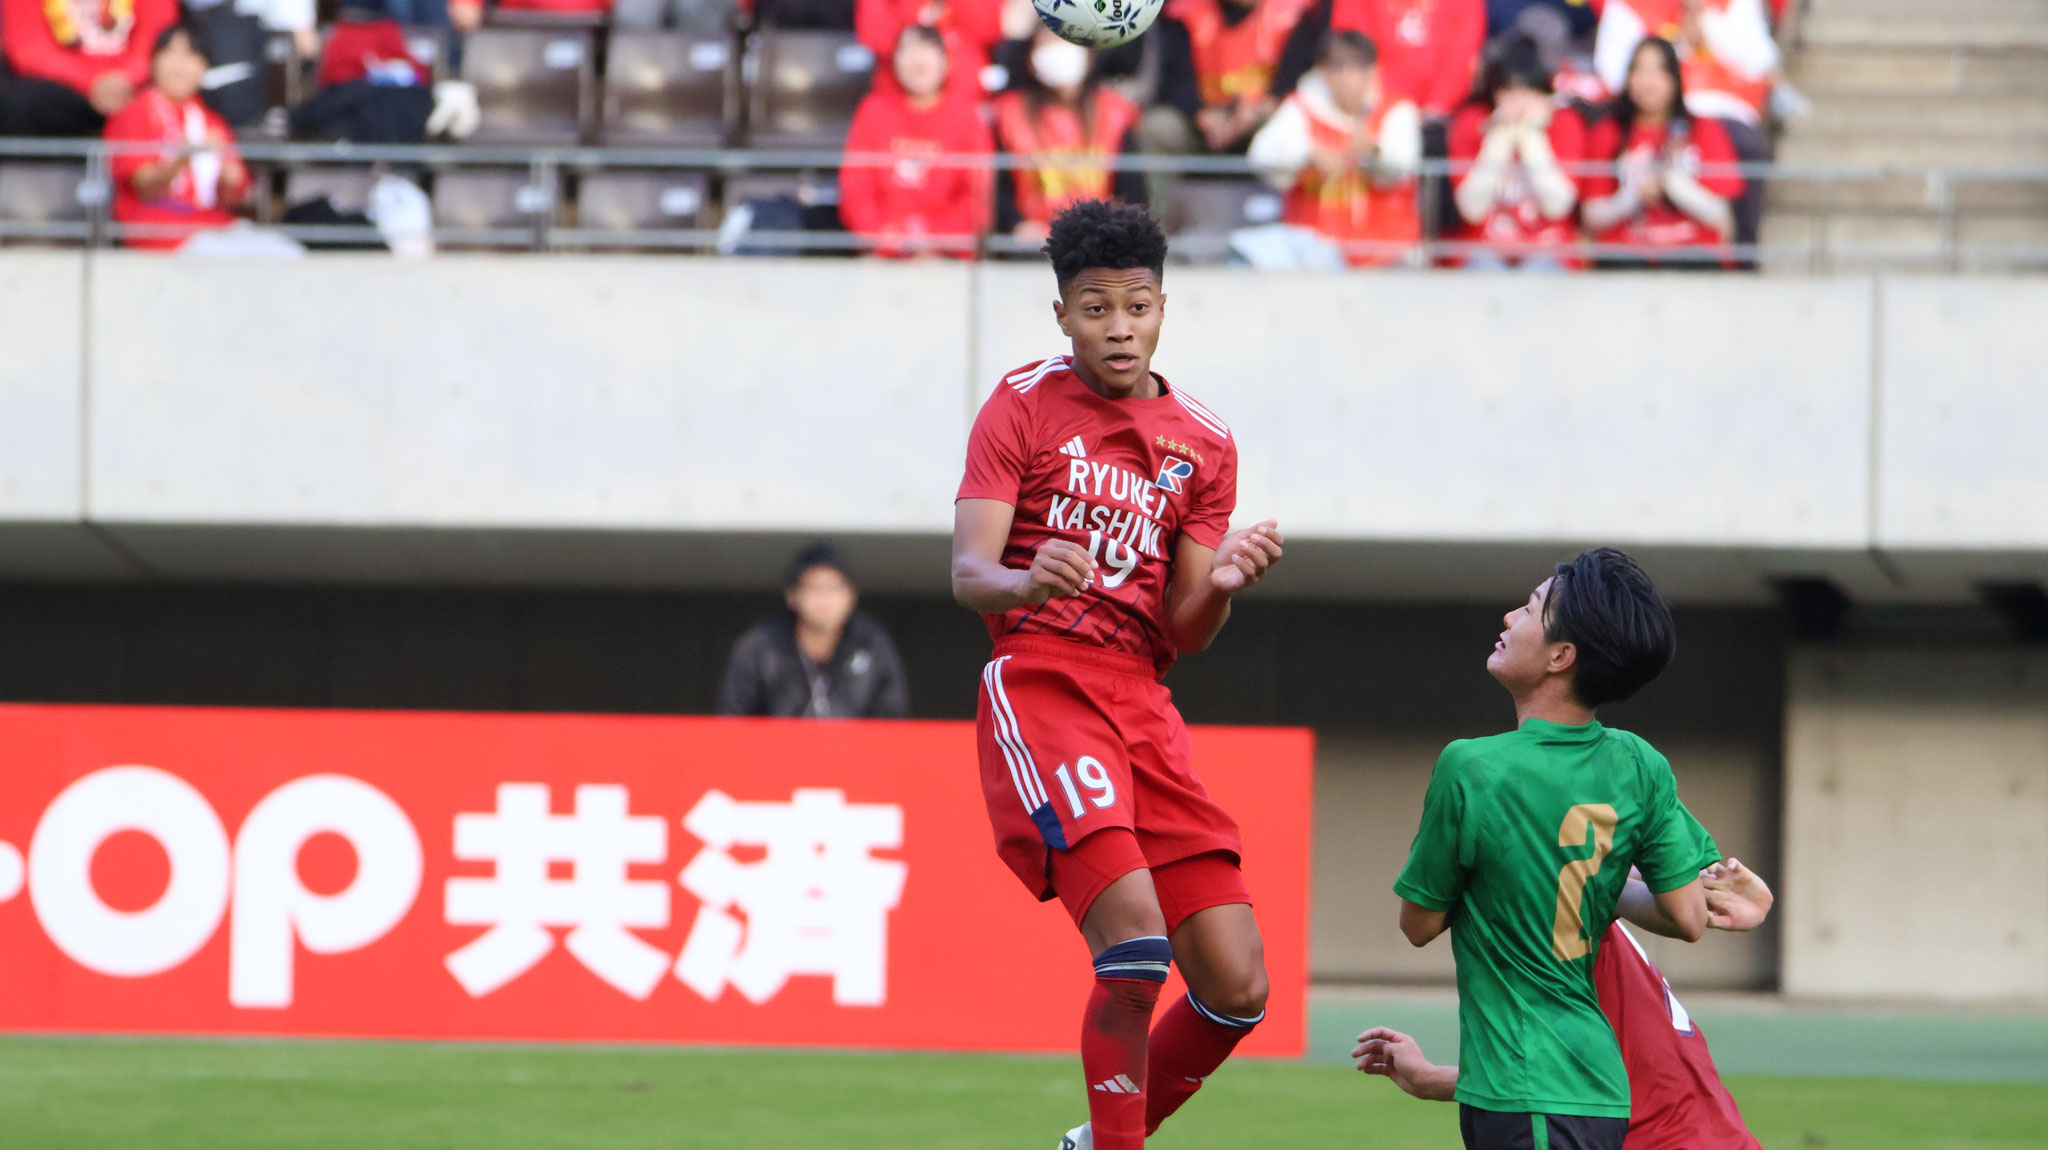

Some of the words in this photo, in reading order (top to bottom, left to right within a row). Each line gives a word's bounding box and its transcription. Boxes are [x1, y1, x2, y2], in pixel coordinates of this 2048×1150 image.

[1068, 459, 1167, 519] RYUKEI
[1055, 754, 1116, 819] 19
[1551, 803, 1619, 962] 2
